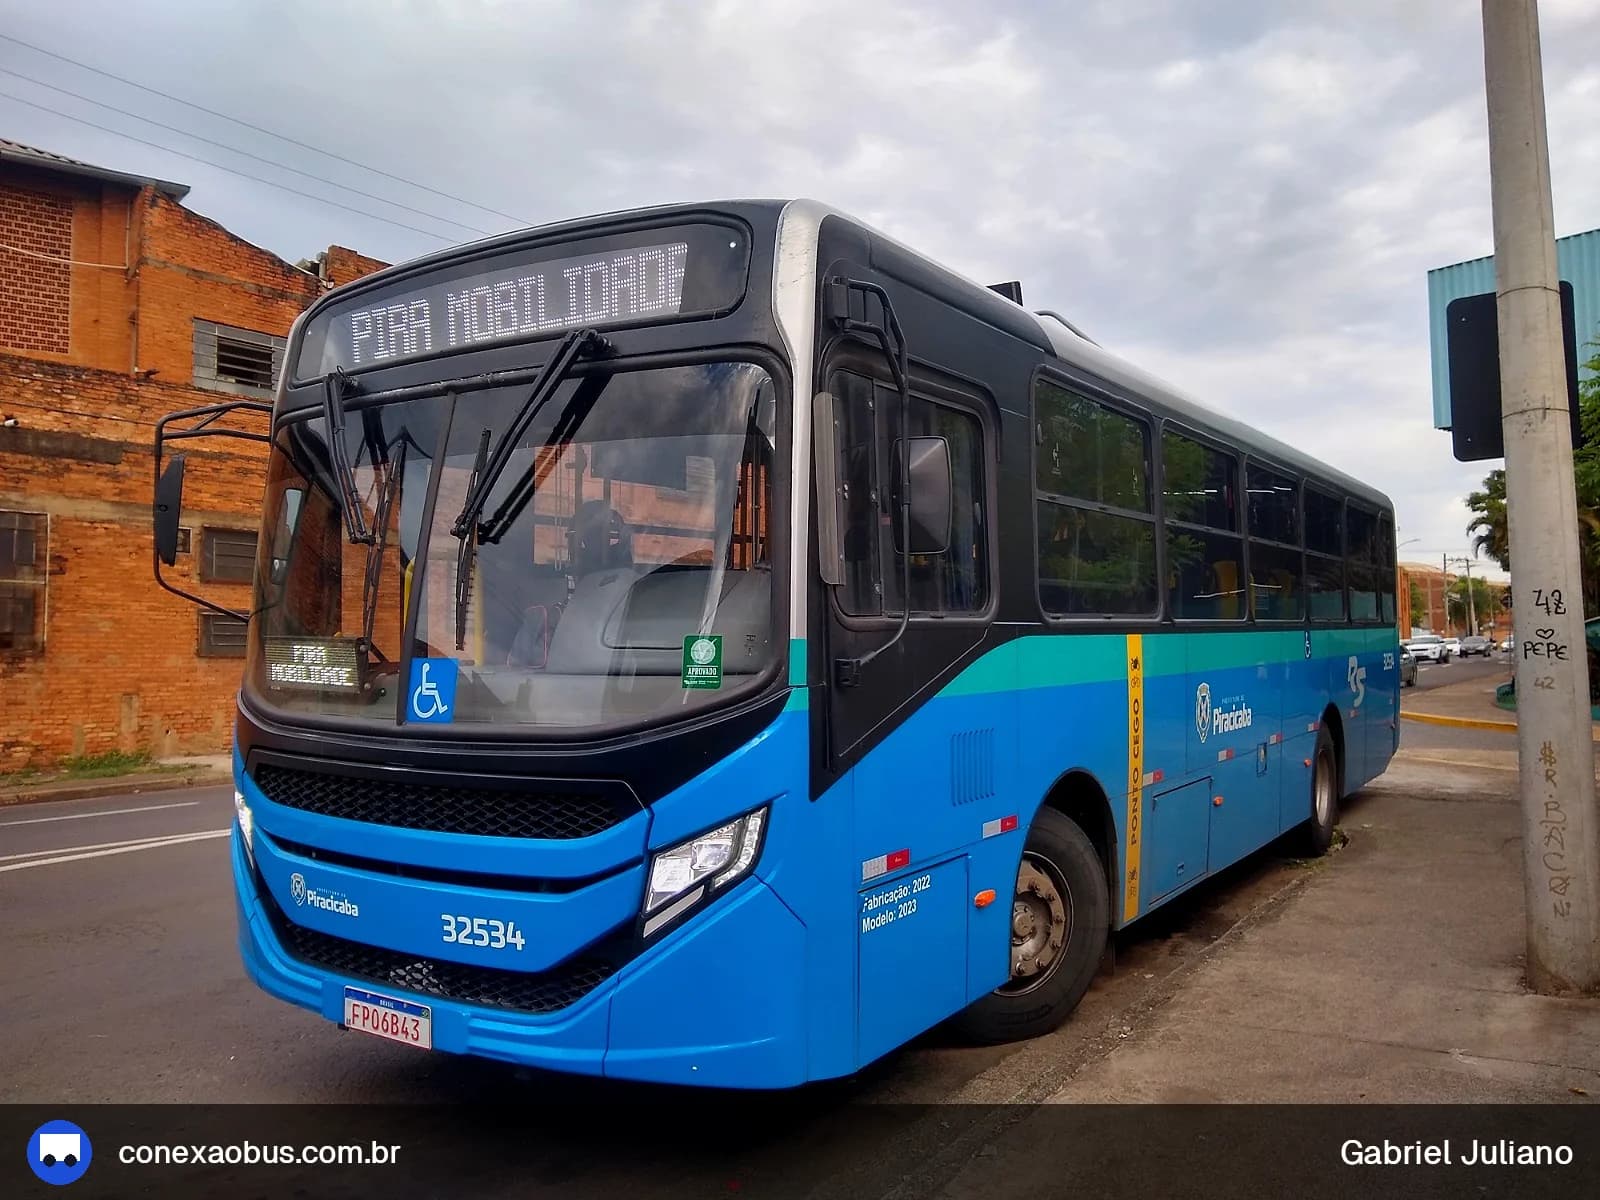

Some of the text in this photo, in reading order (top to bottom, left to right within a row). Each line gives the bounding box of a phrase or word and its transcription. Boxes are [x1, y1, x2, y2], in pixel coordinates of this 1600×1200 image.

[351, 243, 688, 363] PIRA MOBILIDADE
[1523, 641, 1570, 661] PEPE
[687, 667, 718, 676] APROVADO
[1213, 702, 1252, 736] Piracicaba
[1130, 698, 1140, 846] PONTO CEGO
[307, 889, 359, 917] Piracicaba
[862, 874, 931, 913] Fabricação: 2022
[441, 914, 526, 951] 32534
[862, 898, 917, 934] Modelo: 2023
